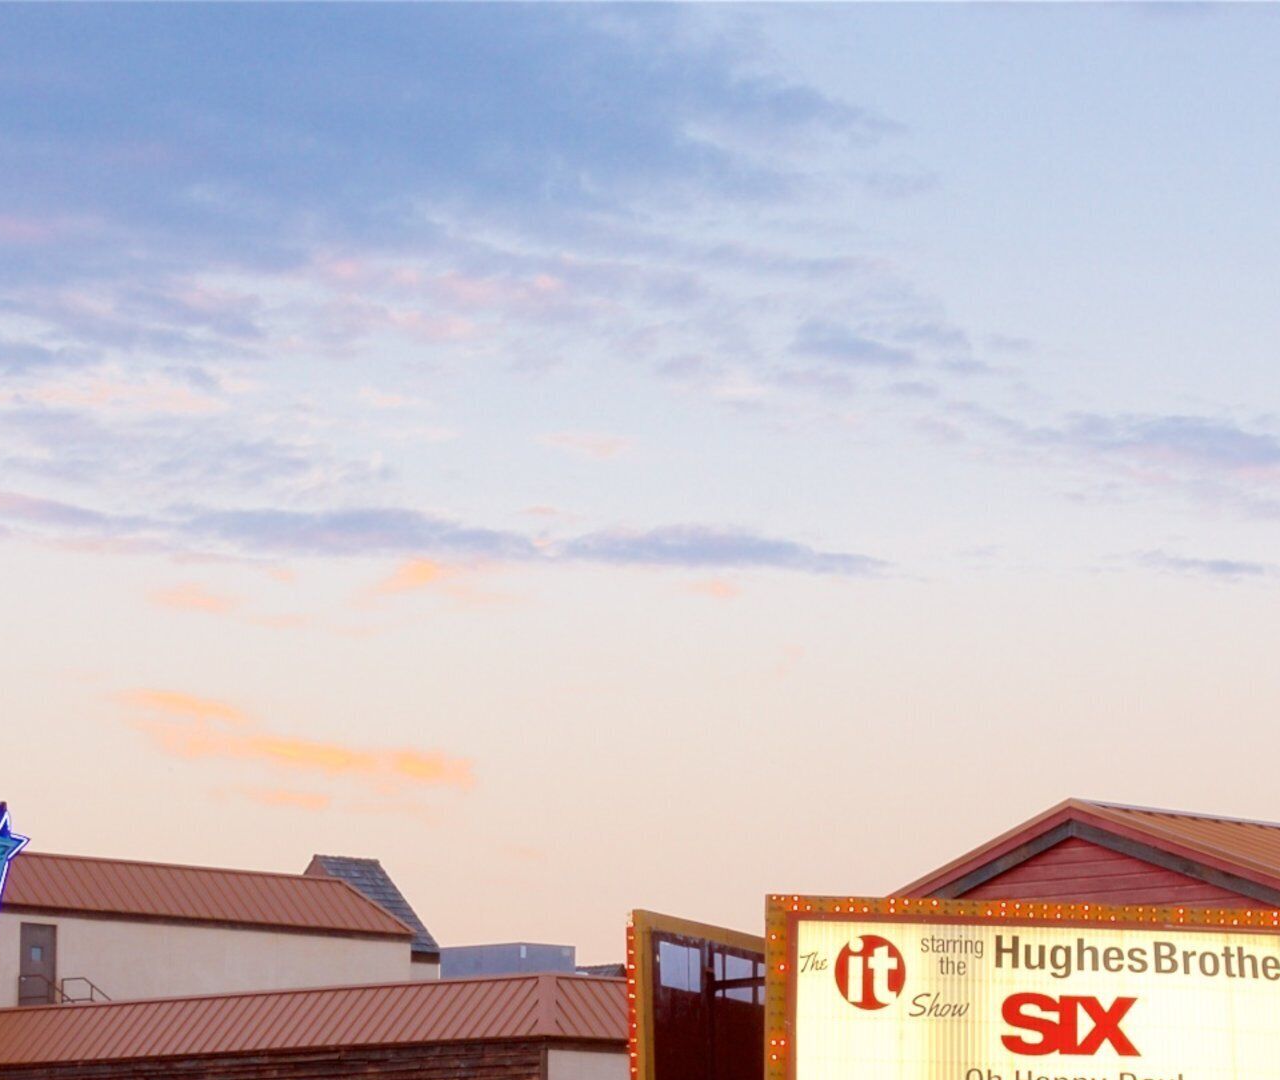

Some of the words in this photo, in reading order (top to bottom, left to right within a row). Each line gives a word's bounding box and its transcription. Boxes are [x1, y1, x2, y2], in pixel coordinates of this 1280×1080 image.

[920, 934, 984, 958] starring
[994, 934, 1148, 978] Hughes
[800, 951, 828, 973] The
[848, 936, 898, 1006] it
[940, 957, 966, 975] the
[908, 992, 970, 1018] Show
[1000, 992, 1142, 1057] SIX
